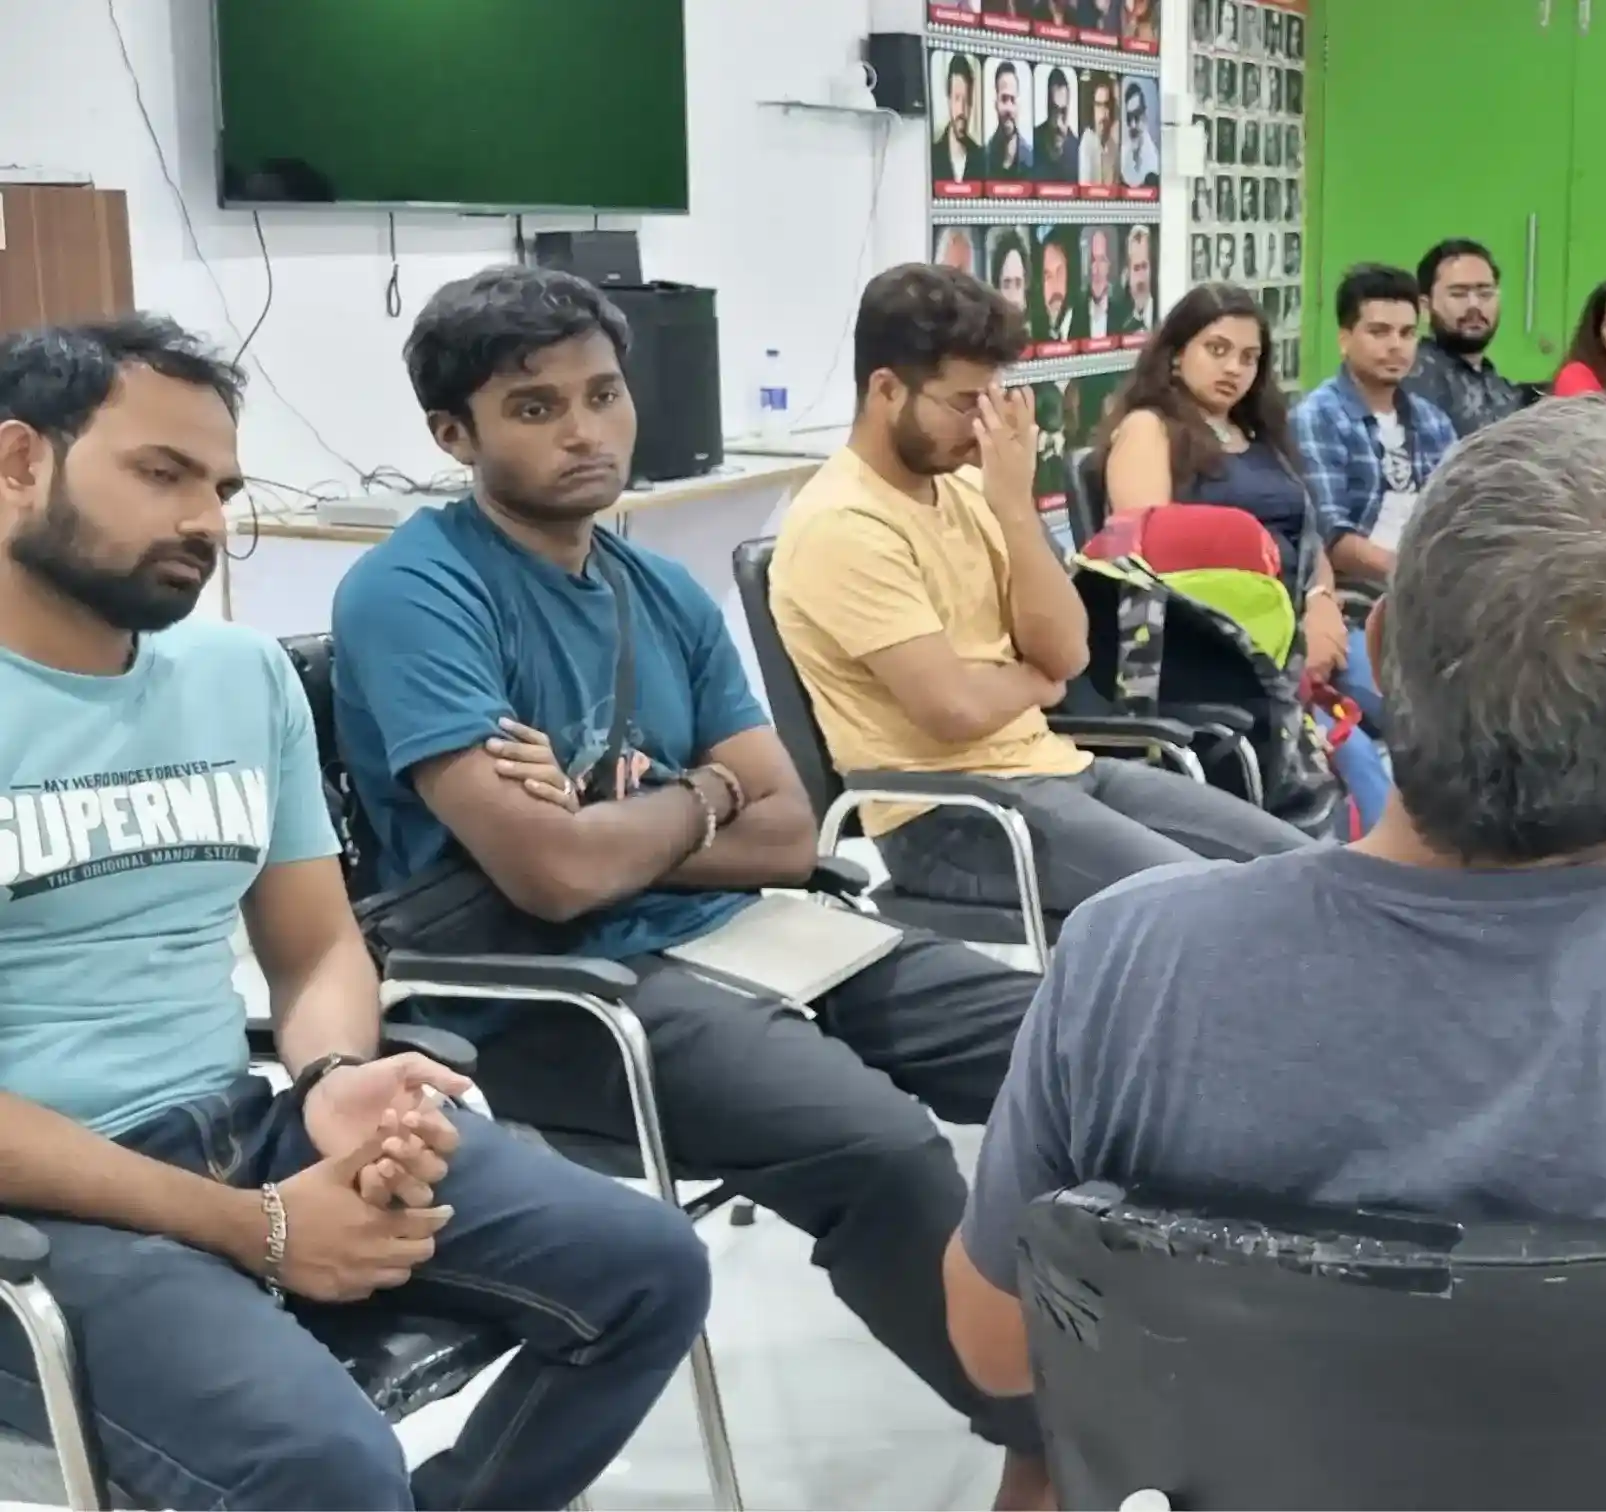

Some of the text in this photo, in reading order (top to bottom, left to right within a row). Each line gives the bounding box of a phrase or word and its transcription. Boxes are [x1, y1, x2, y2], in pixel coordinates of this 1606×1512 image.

[43, 779, 69, 793] MY
[47, 870, 76, 889] THE
[82, 854, 147, 878] ORIGINAL
[203, 846, 240, 860] STEEL
